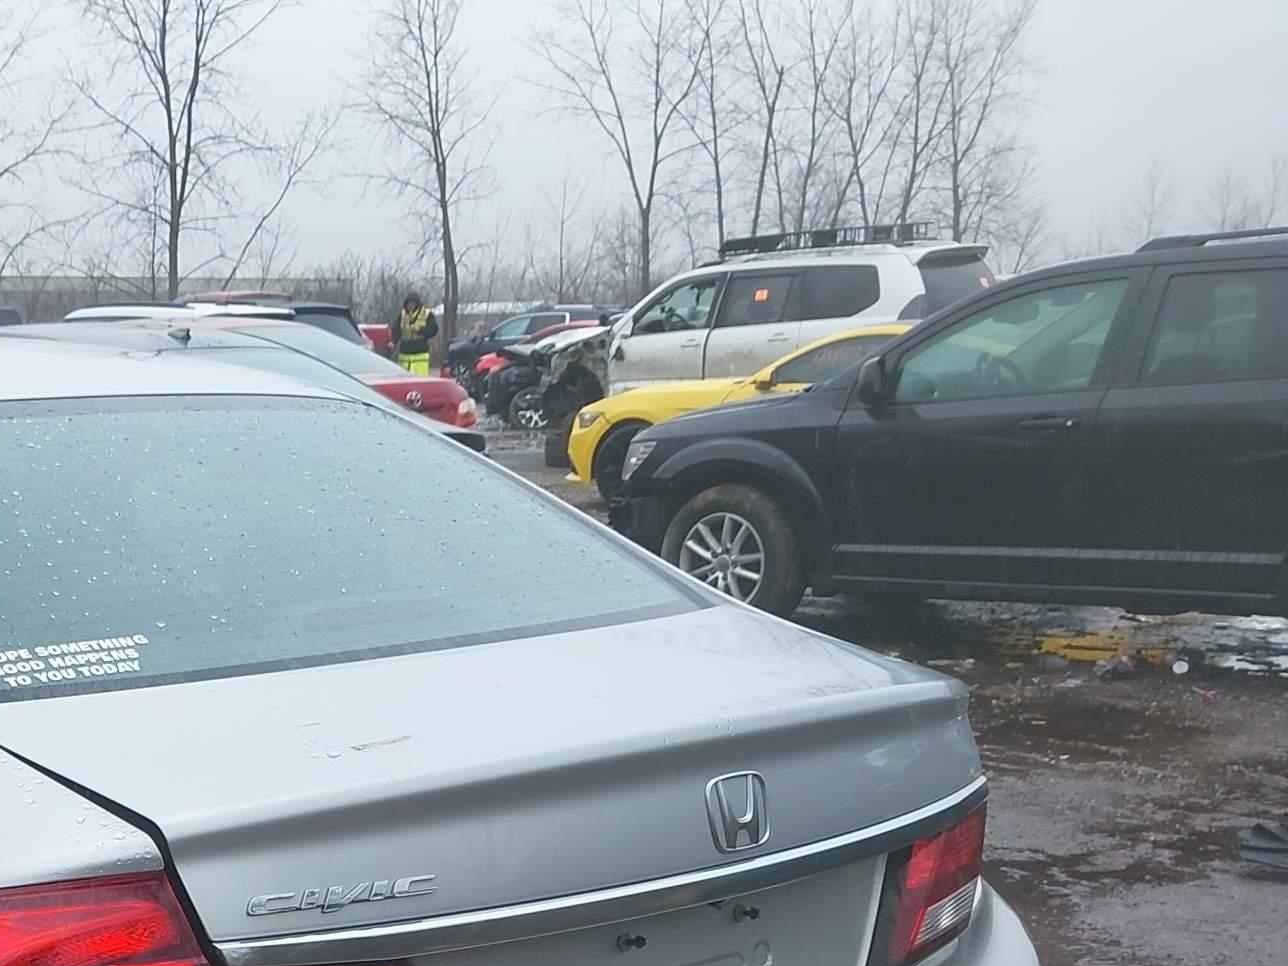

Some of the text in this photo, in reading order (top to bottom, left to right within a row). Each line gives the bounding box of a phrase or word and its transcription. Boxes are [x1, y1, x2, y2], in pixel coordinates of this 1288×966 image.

[34, 634, 149, 657] SOMETHING
[48, 649, 140, 668] HAPPENS
[4, 660, 140, 687] TO YOU TODAY
[246, 873, 438, 916] CIVIC
